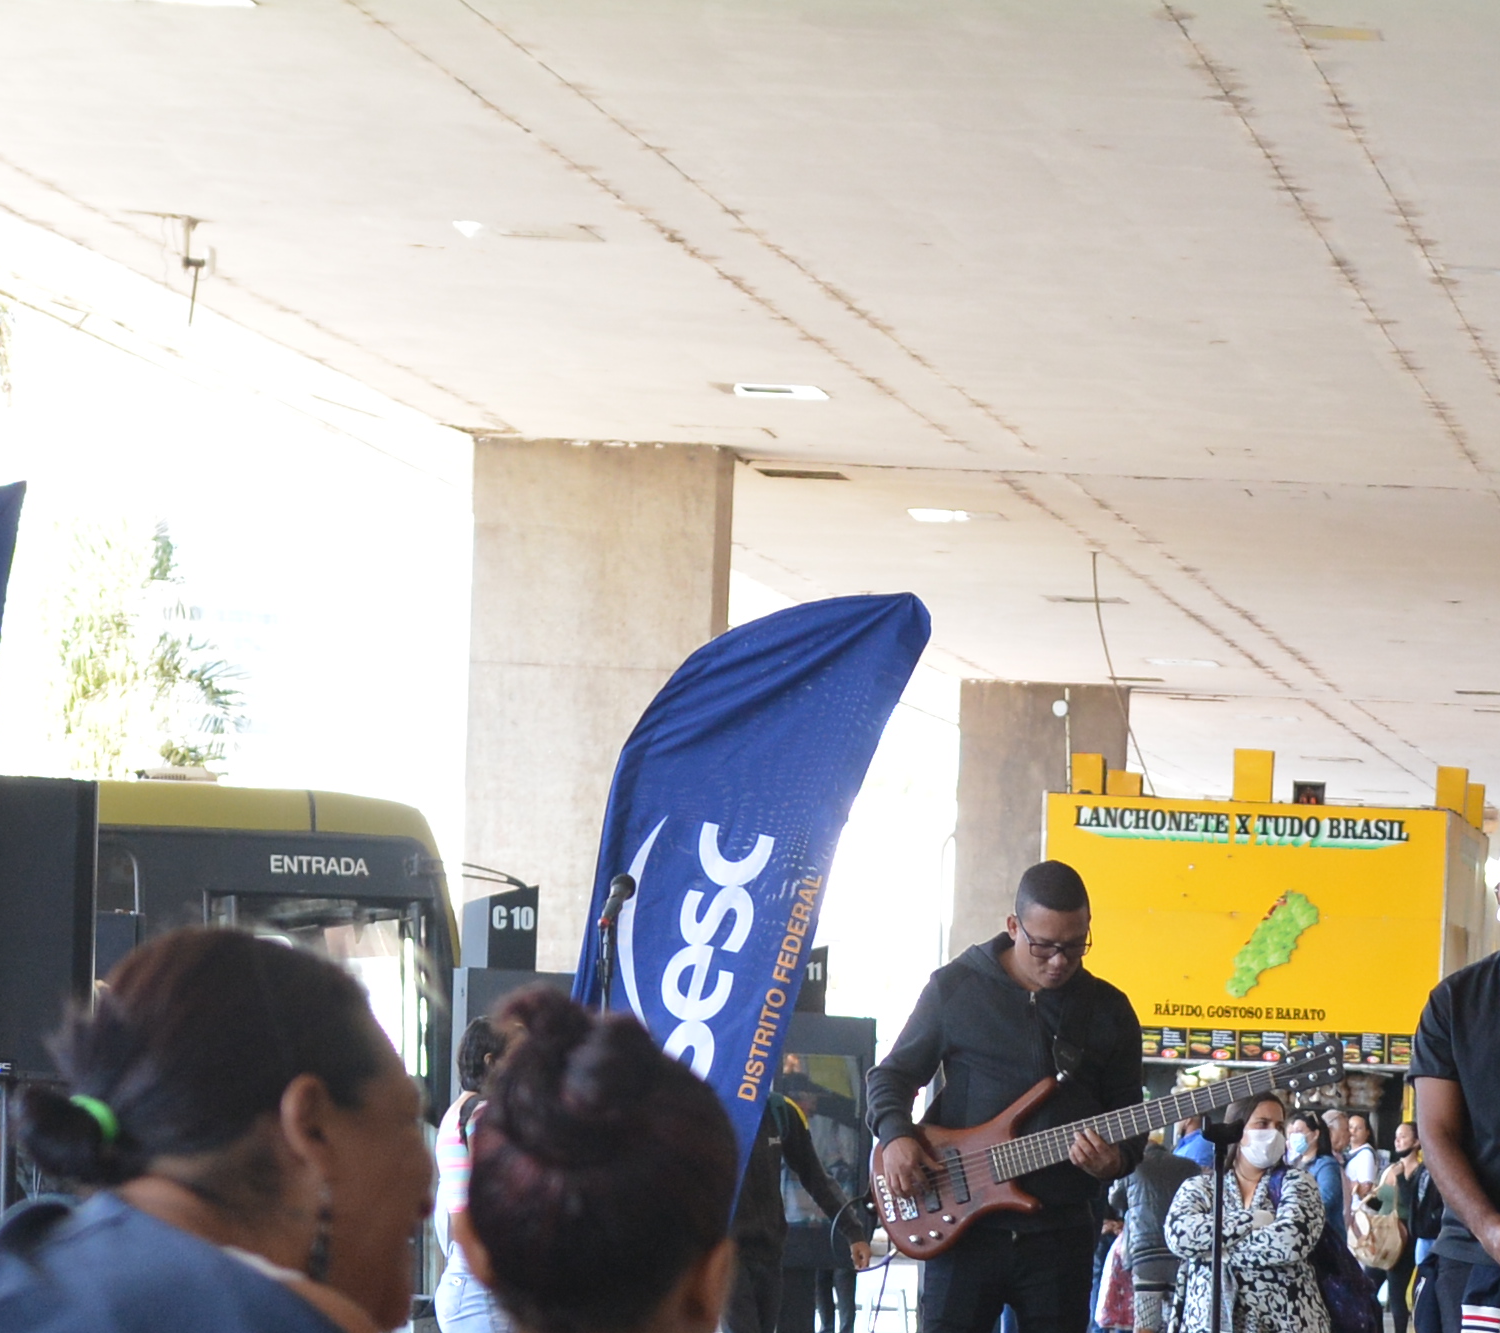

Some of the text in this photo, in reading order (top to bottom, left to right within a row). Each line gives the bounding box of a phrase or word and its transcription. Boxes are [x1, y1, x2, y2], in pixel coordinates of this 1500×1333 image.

[1074, 805, 1410, 842] LANCHONETE X TUDO BRASIL
[269, 853, 370, 877] ENTRADA
[492, 905, 534, 930] C 10
[807, 961, 823, 981] 11
[737, 874, 823, 1102] DISTRITO FEDERAL
[1153, 999, 1327, 1022] RÁPIDO, GOSTOSO E BARATO
